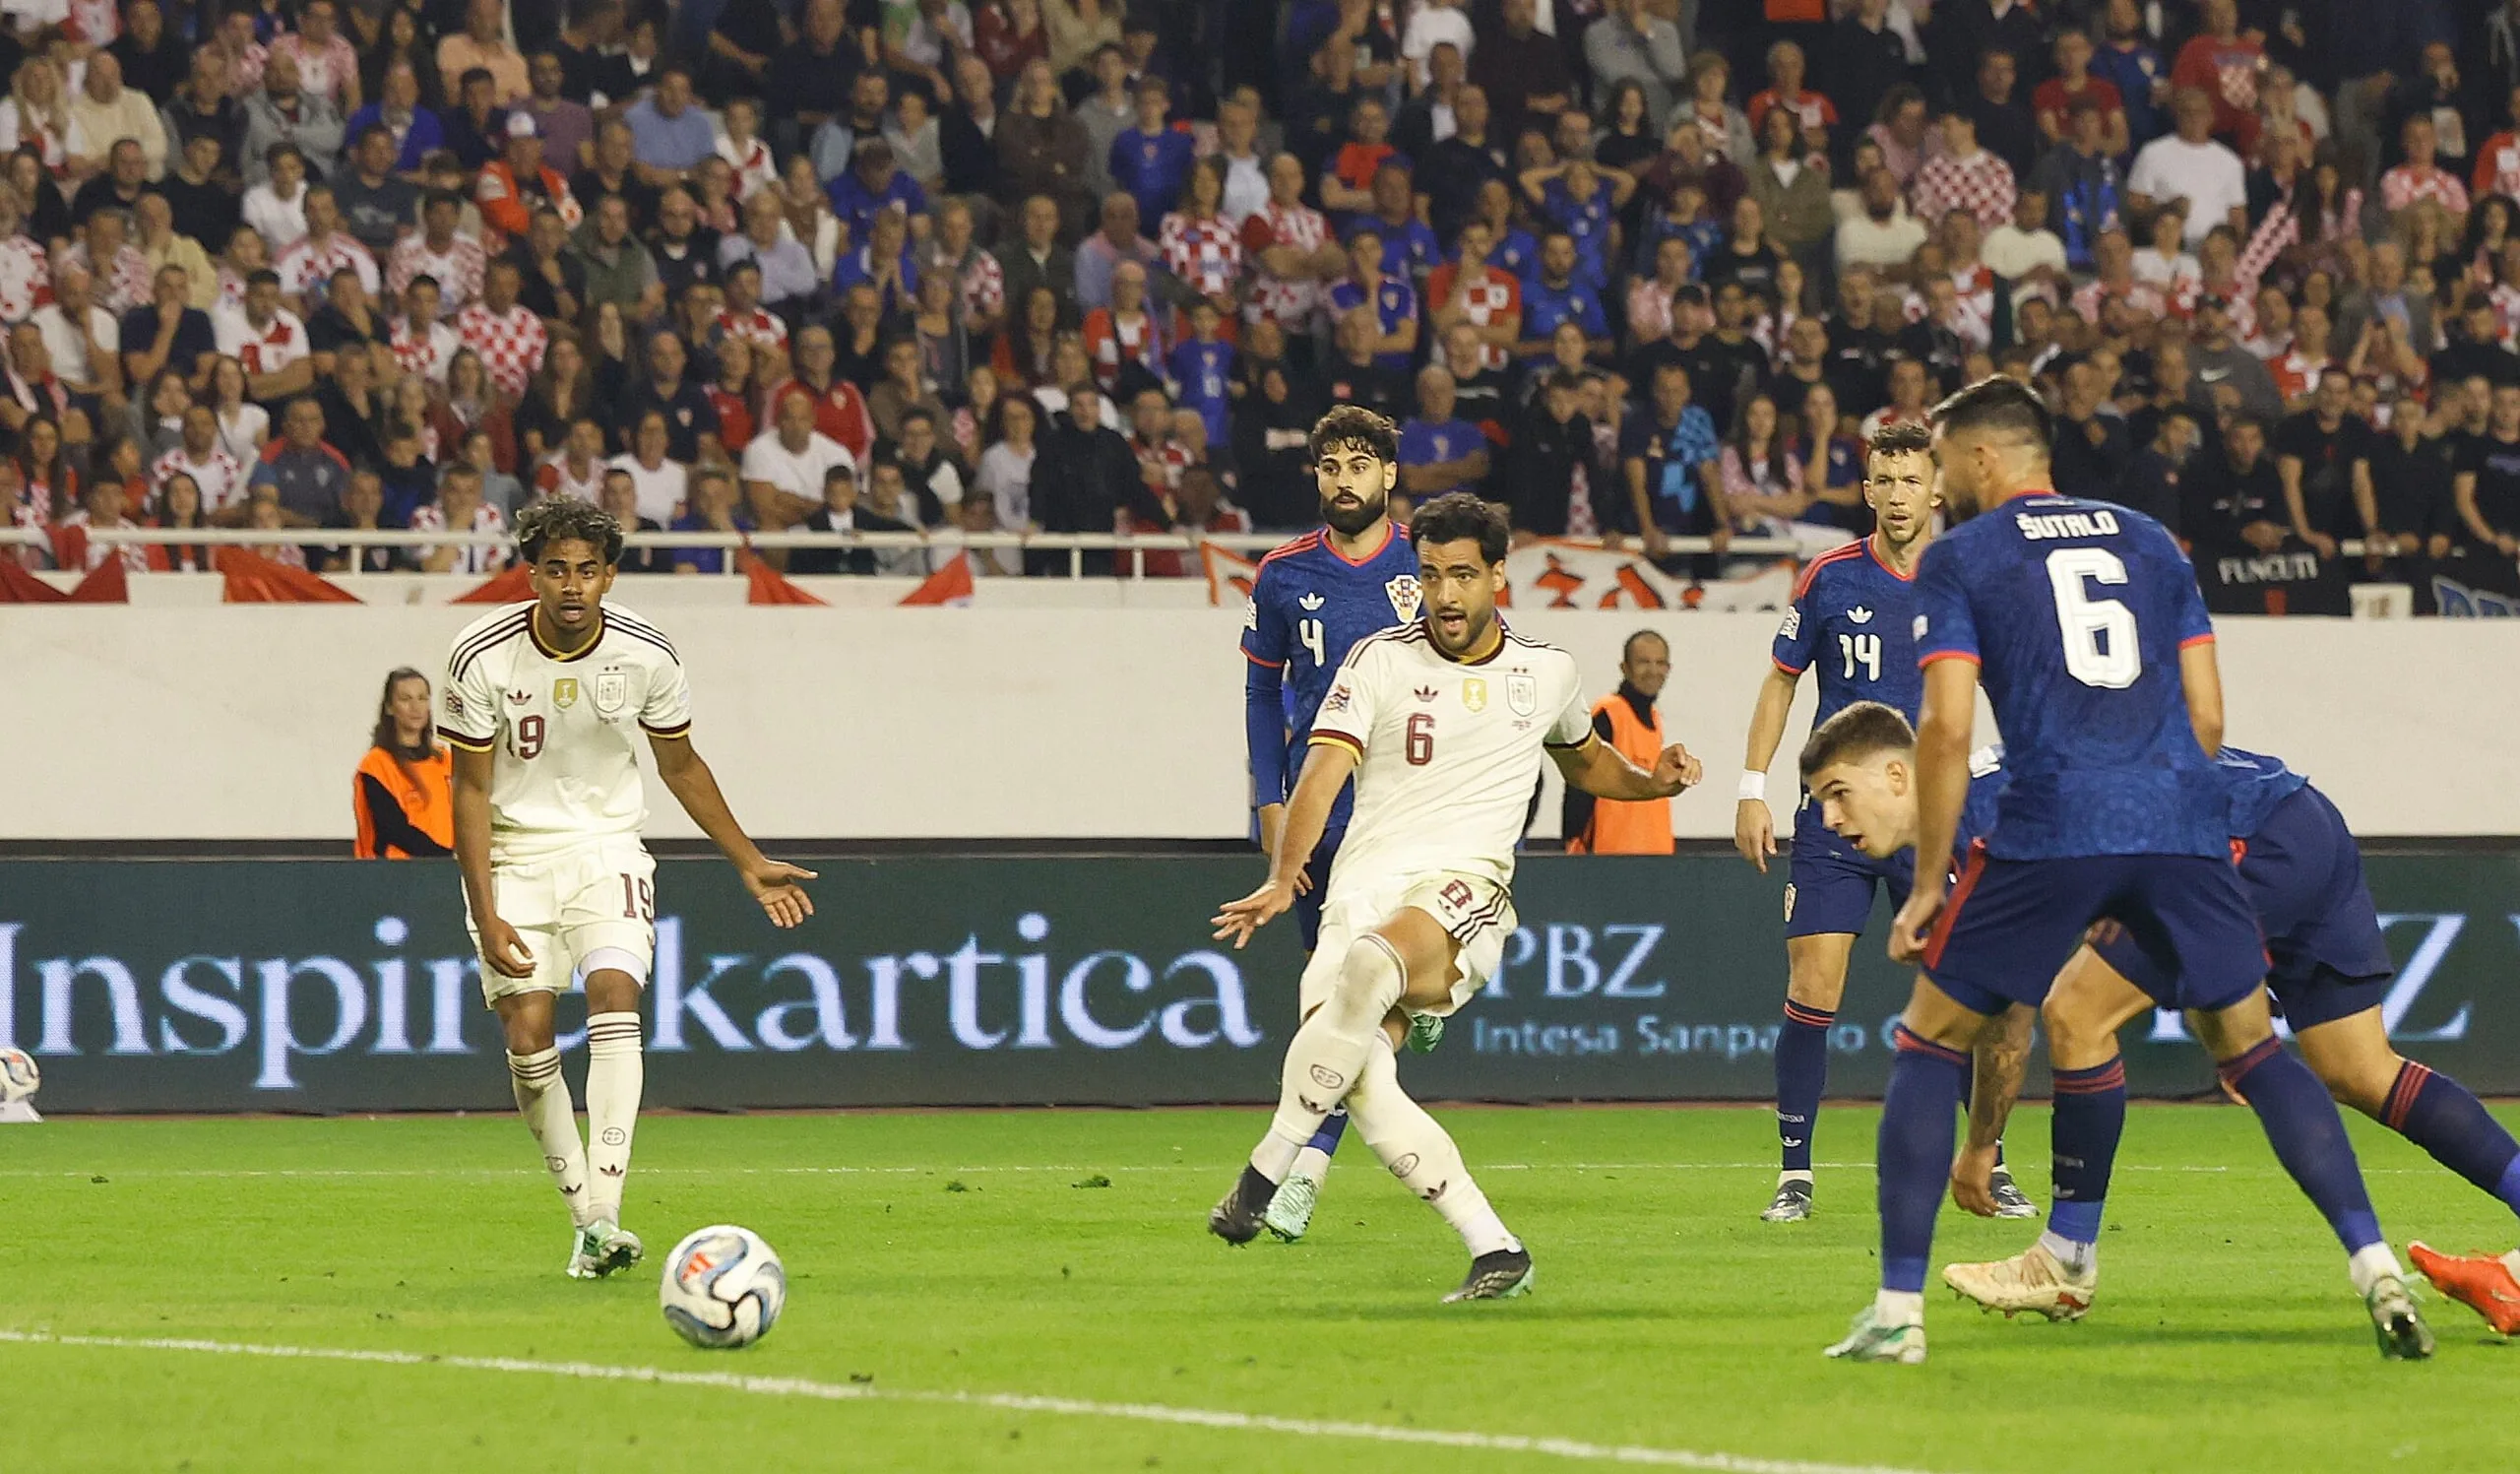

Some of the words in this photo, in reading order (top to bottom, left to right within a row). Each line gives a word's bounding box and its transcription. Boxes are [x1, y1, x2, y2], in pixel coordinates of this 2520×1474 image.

[2016, 510, 2119, 540] ŠUTALO
[1299, 618, 1325, 669] 4
[2045, 547, 2142, 689] 6
[1839, 633, 1882, 682] 14
[1406, 712, 1435, 766] 6
[619, 872, 654, 925] 19
[1484, 923, 1668, 999] PBZ
[0, 917, 590, 1089] Inspir
[648, 913, 1262, 1052] kartica
[1475, 1016, 1622, 1053] Intesa
[1637, 1015, 1866, 1059] Sanpao
